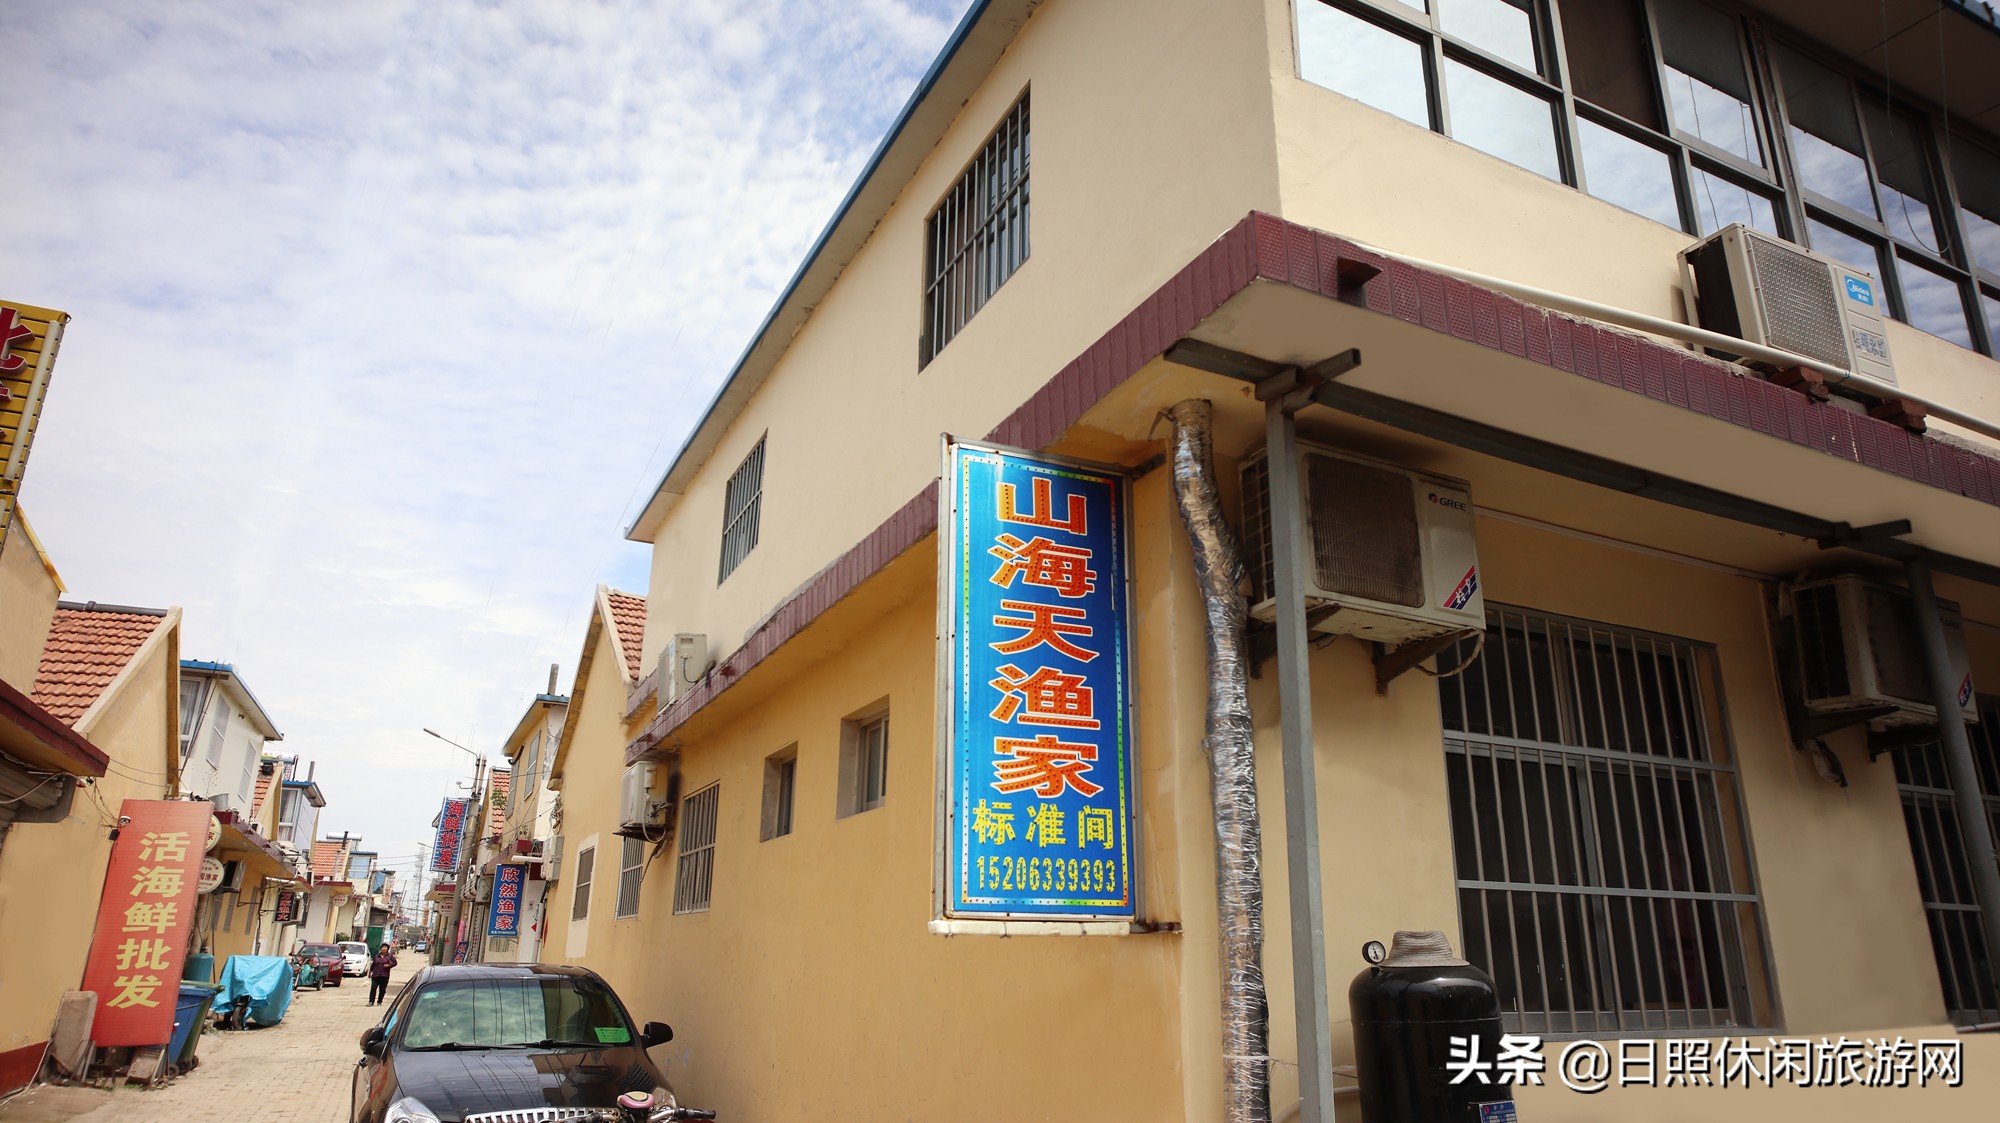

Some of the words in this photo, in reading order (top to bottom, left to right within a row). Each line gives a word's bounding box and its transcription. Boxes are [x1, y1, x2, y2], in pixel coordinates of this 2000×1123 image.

[1846, 279, 1870, 296] Midea
[1440, 498, 1467, 511] GREE
[988, 476, 1103, 798] 山海天渔家
[438, 801, 464, 865] 海鲜批发
[971, 798, 1115, 850] 标准间
[495, 867, 519, 930] 欣然渔家
[976, 855, 1116, 893] 15206339393
[106, 831, 190, 1009] 活海鲜批发
